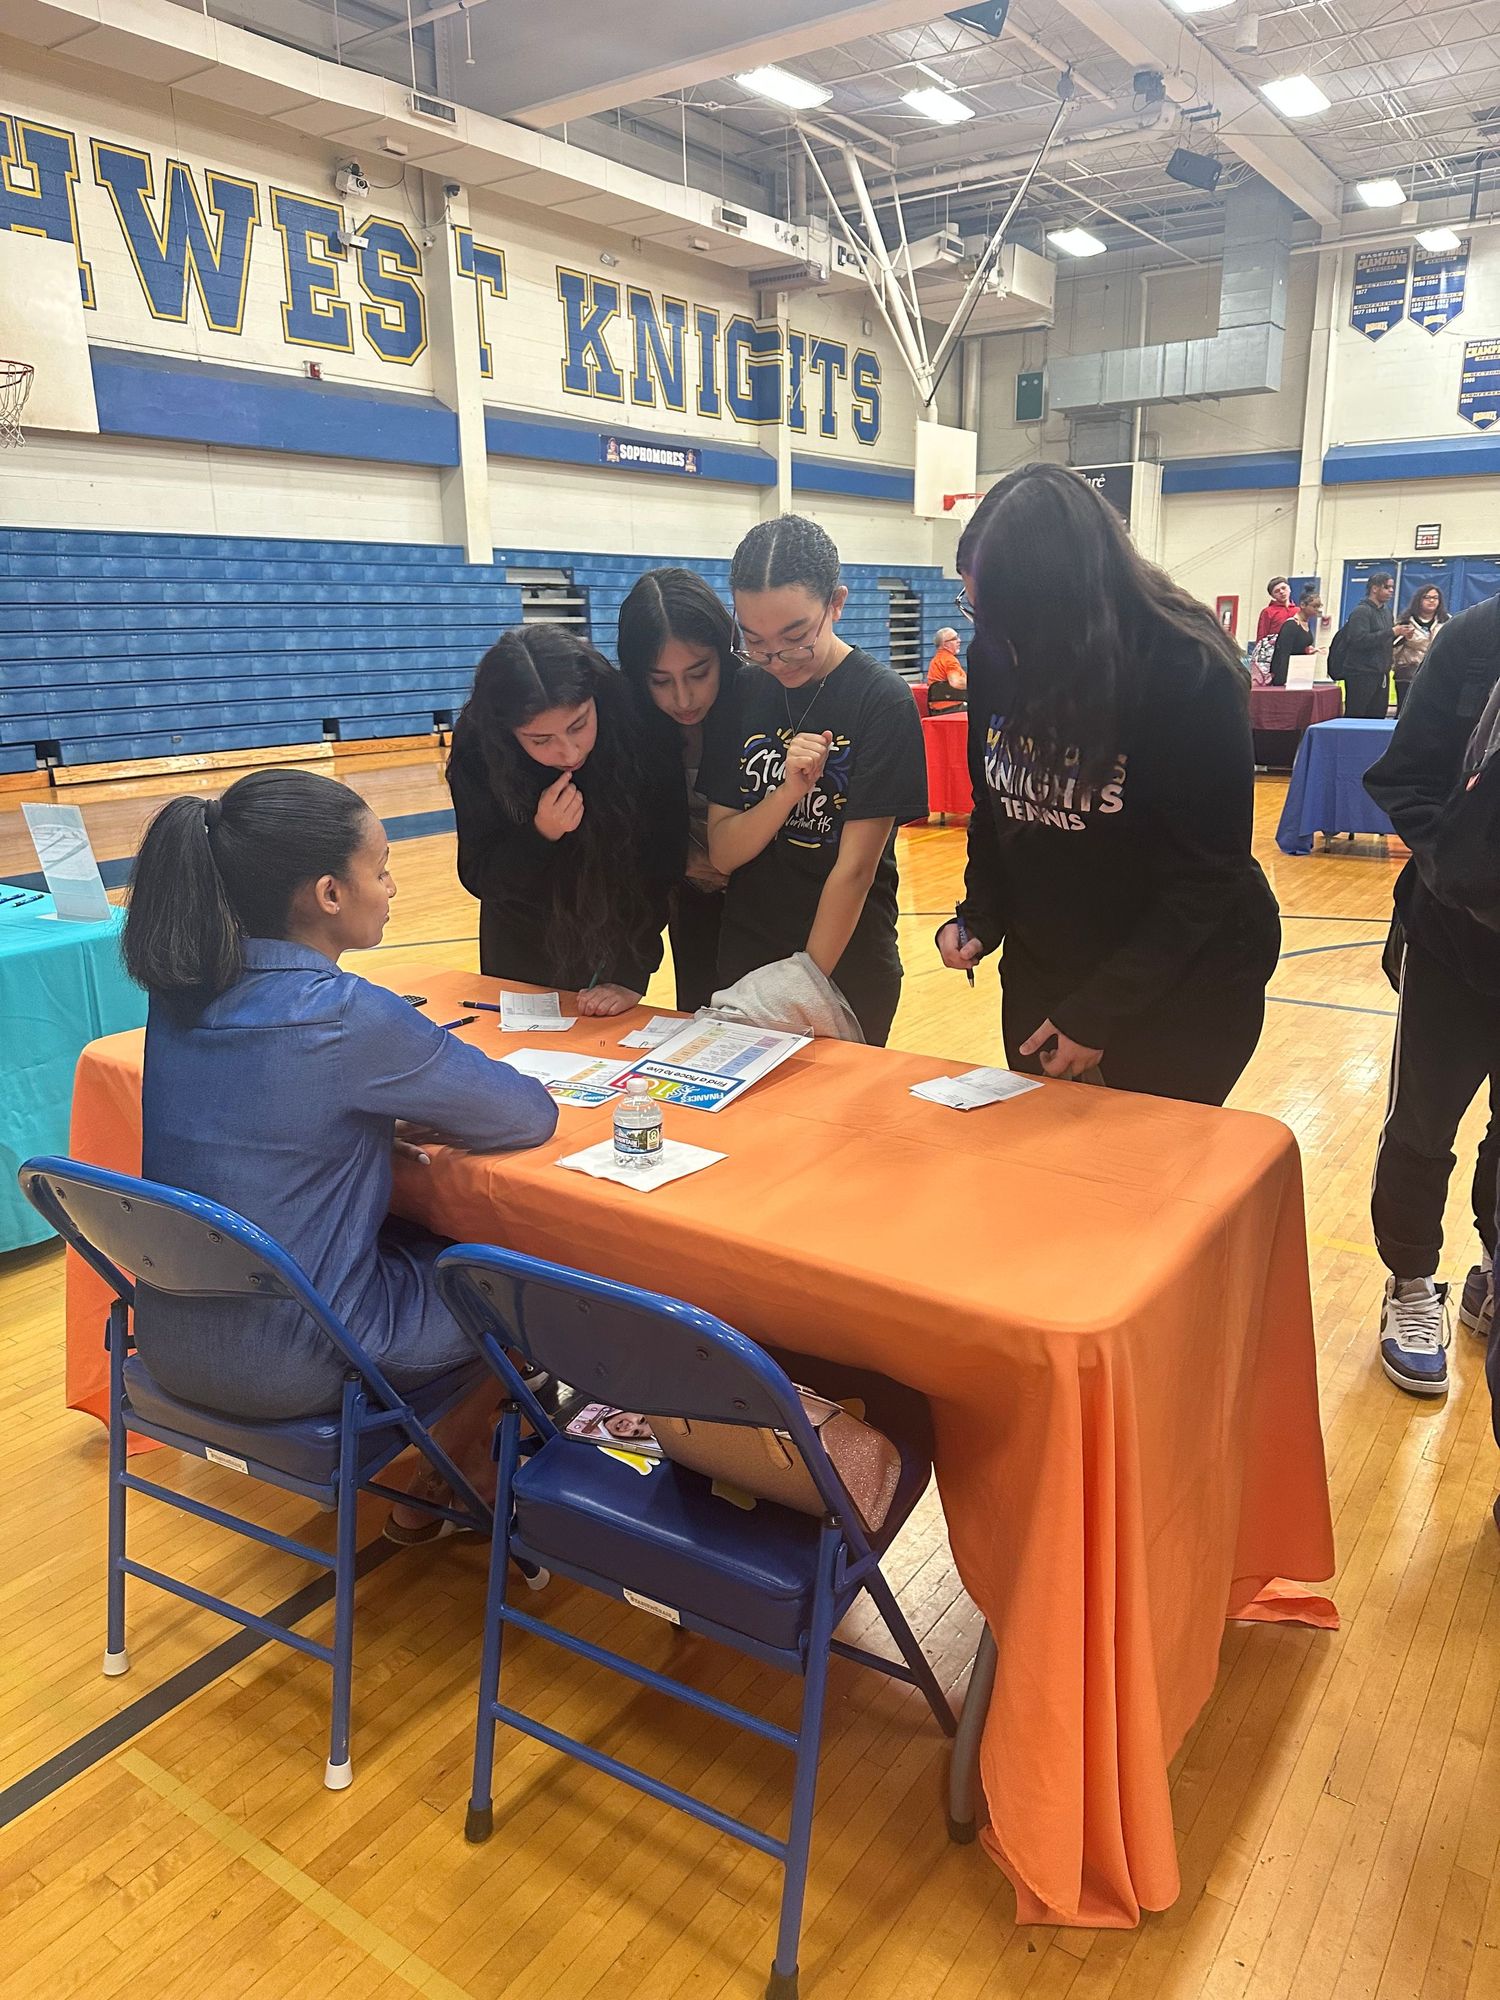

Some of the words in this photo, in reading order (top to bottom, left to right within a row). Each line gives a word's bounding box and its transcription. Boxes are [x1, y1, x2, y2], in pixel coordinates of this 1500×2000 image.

[1360, 249, 1406, 260] BASEBALL
[1357, 253, 1408, 270] CHAMPIONS
[619, 444, 685, 467] SOPHOMORES
[1000, 796, 1087, 831] TENNIS
[646, 1066, 665, 1075] Live
[674, 1072, 700, 1082] Place
[705, 1079, 728, 1088] Find
[680, 1091, 726, 1104] FINANCES
